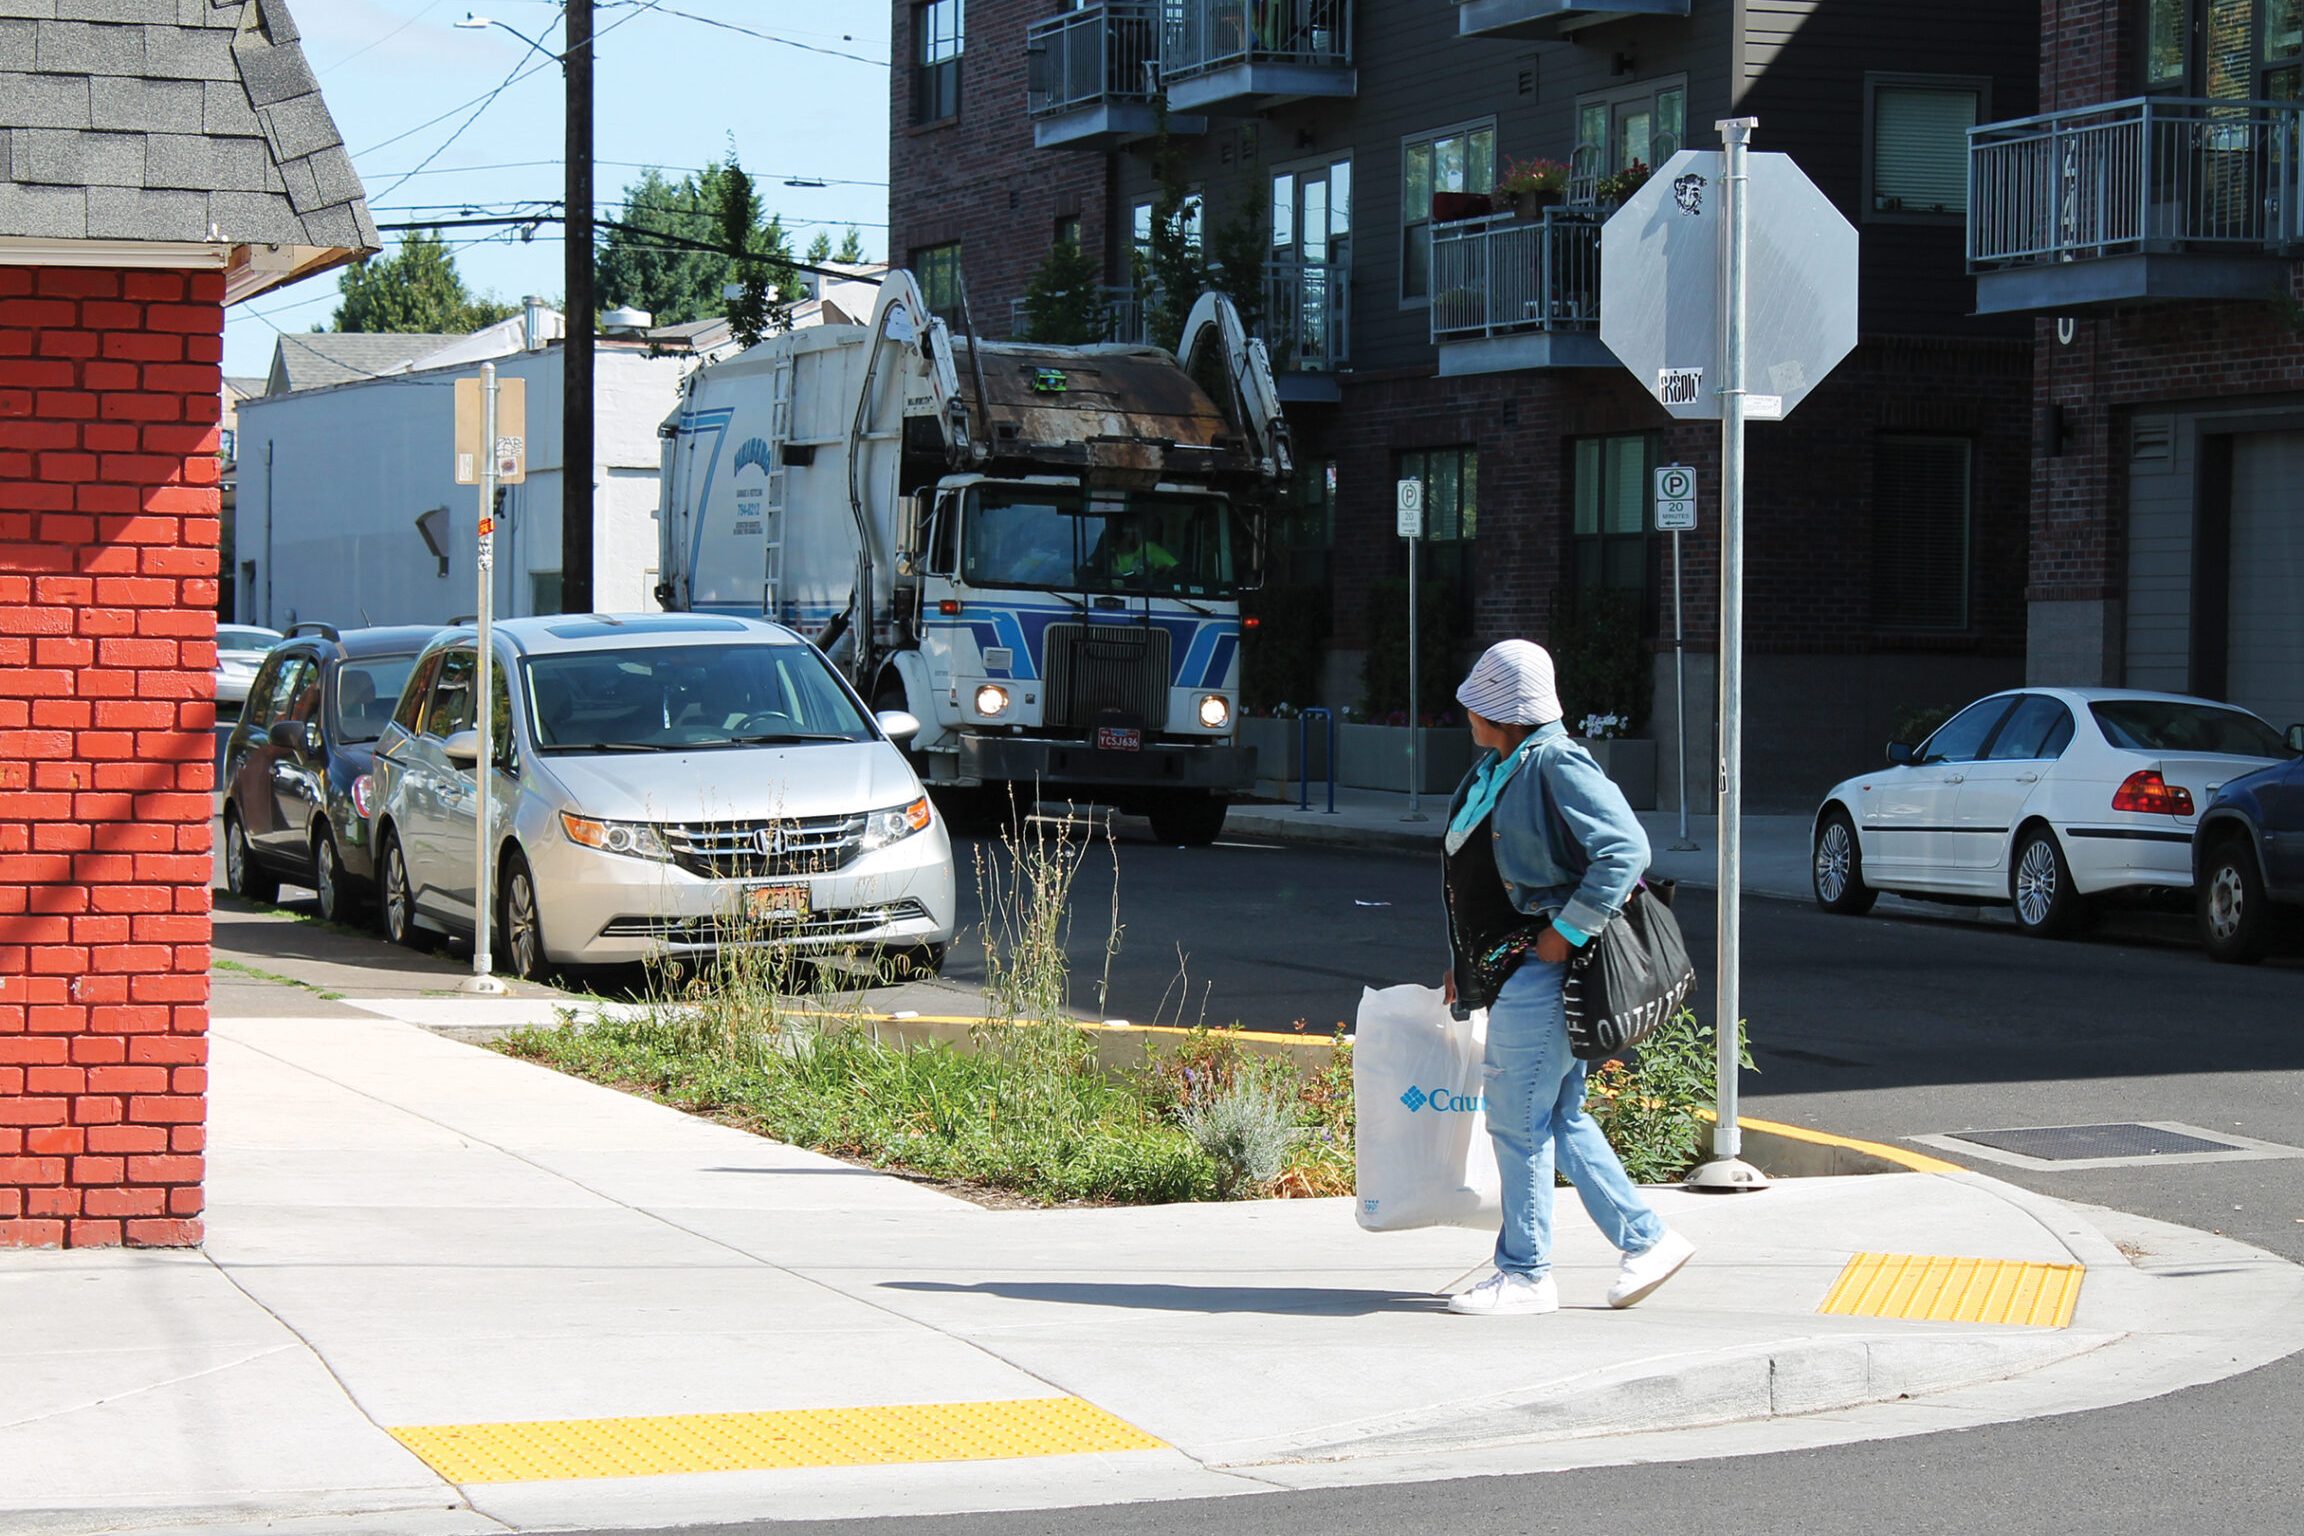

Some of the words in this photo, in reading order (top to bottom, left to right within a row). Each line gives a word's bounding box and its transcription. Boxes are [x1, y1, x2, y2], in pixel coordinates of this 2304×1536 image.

[1669, 477, 1683, 493] P
[1406, 489, 1414, 503] P
[1668, 503, 1684, 512] 20
